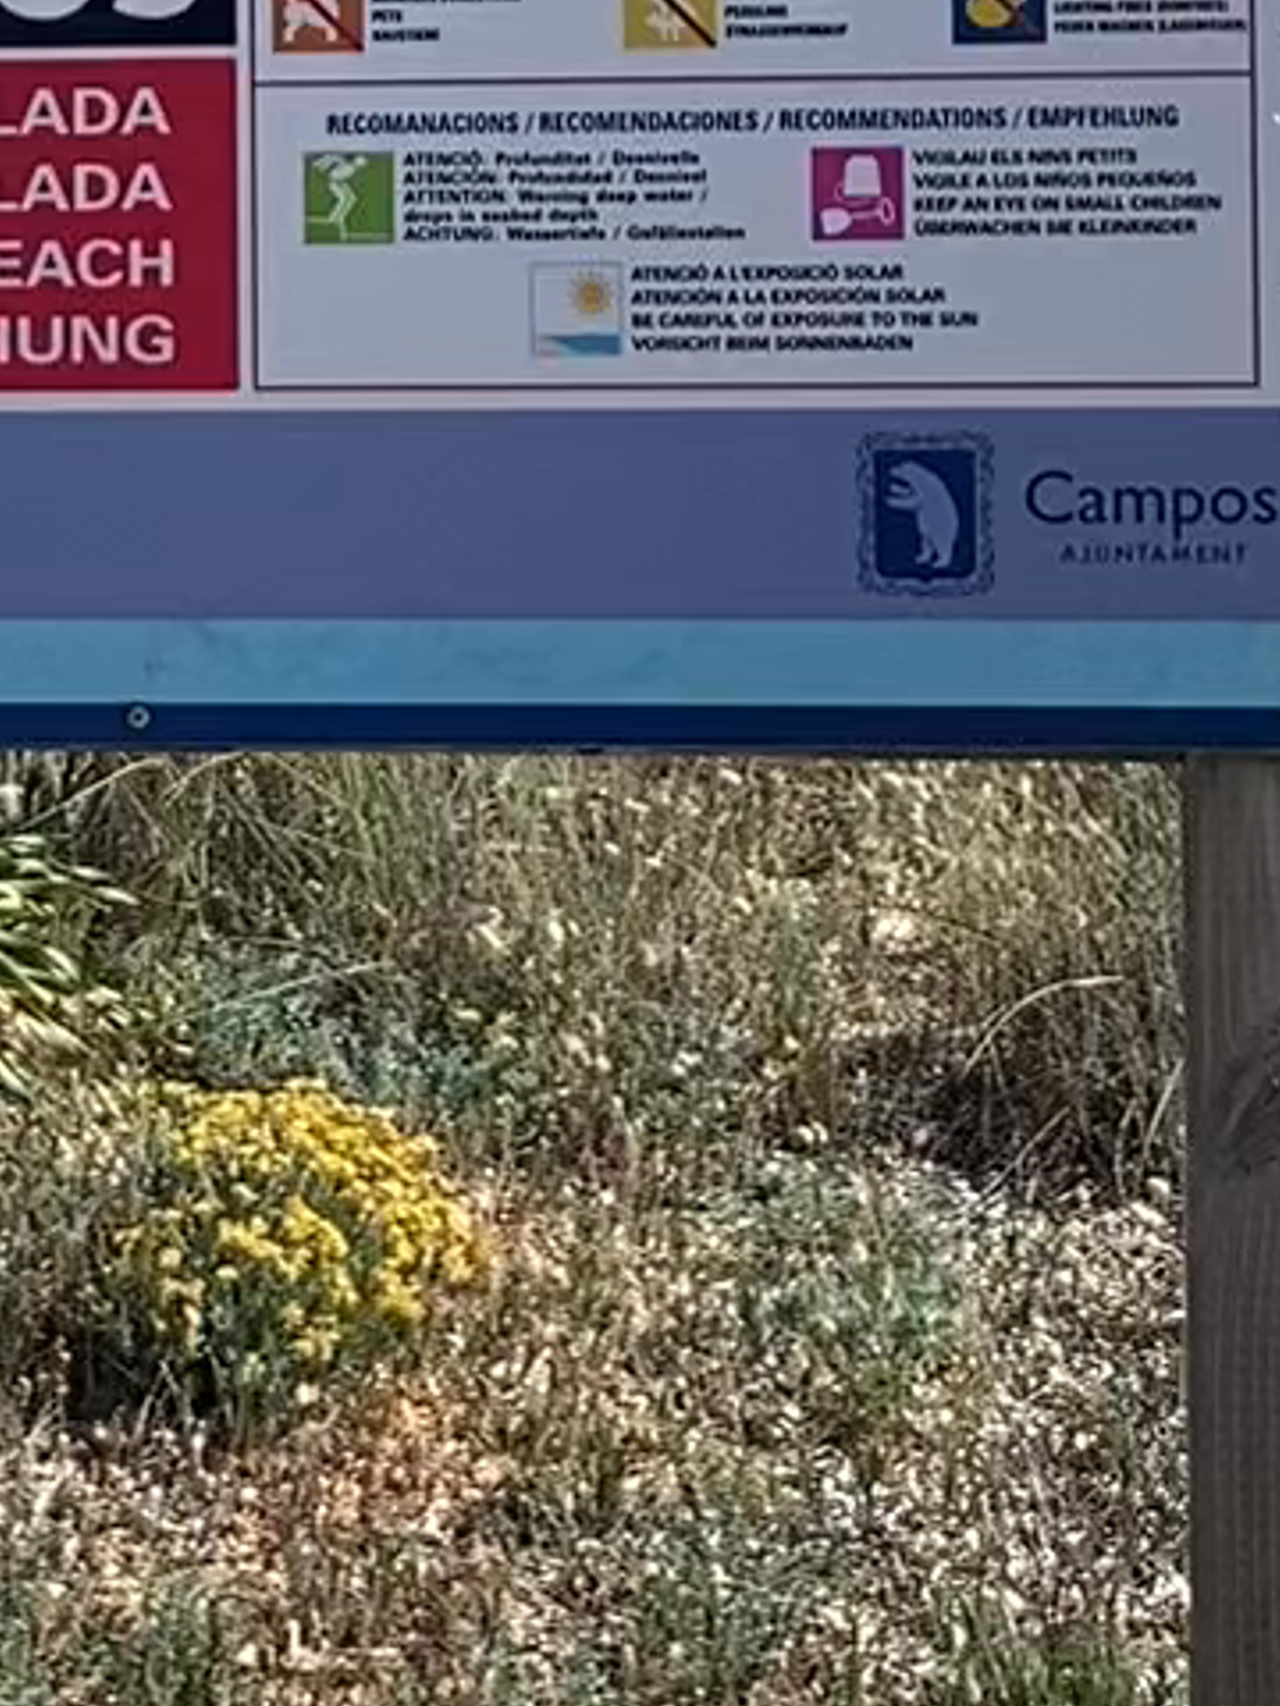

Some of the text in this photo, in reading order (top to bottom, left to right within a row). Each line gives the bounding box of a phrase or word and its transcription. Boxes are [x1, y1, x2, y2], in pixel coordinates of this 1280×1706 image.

[325, 110, 520, 135] RECOMANACIONS
[539, 108, 760, 134] RECOMENDACIONES
[779, 106, 1007, 132] RECOMMENDATIONS
[1027, 104, 1180, 130] EMPFEHLUNG
[1024, 469, 1279, 540] Campos
[1058, 542, 1247, 566] AJUNTAMENT
